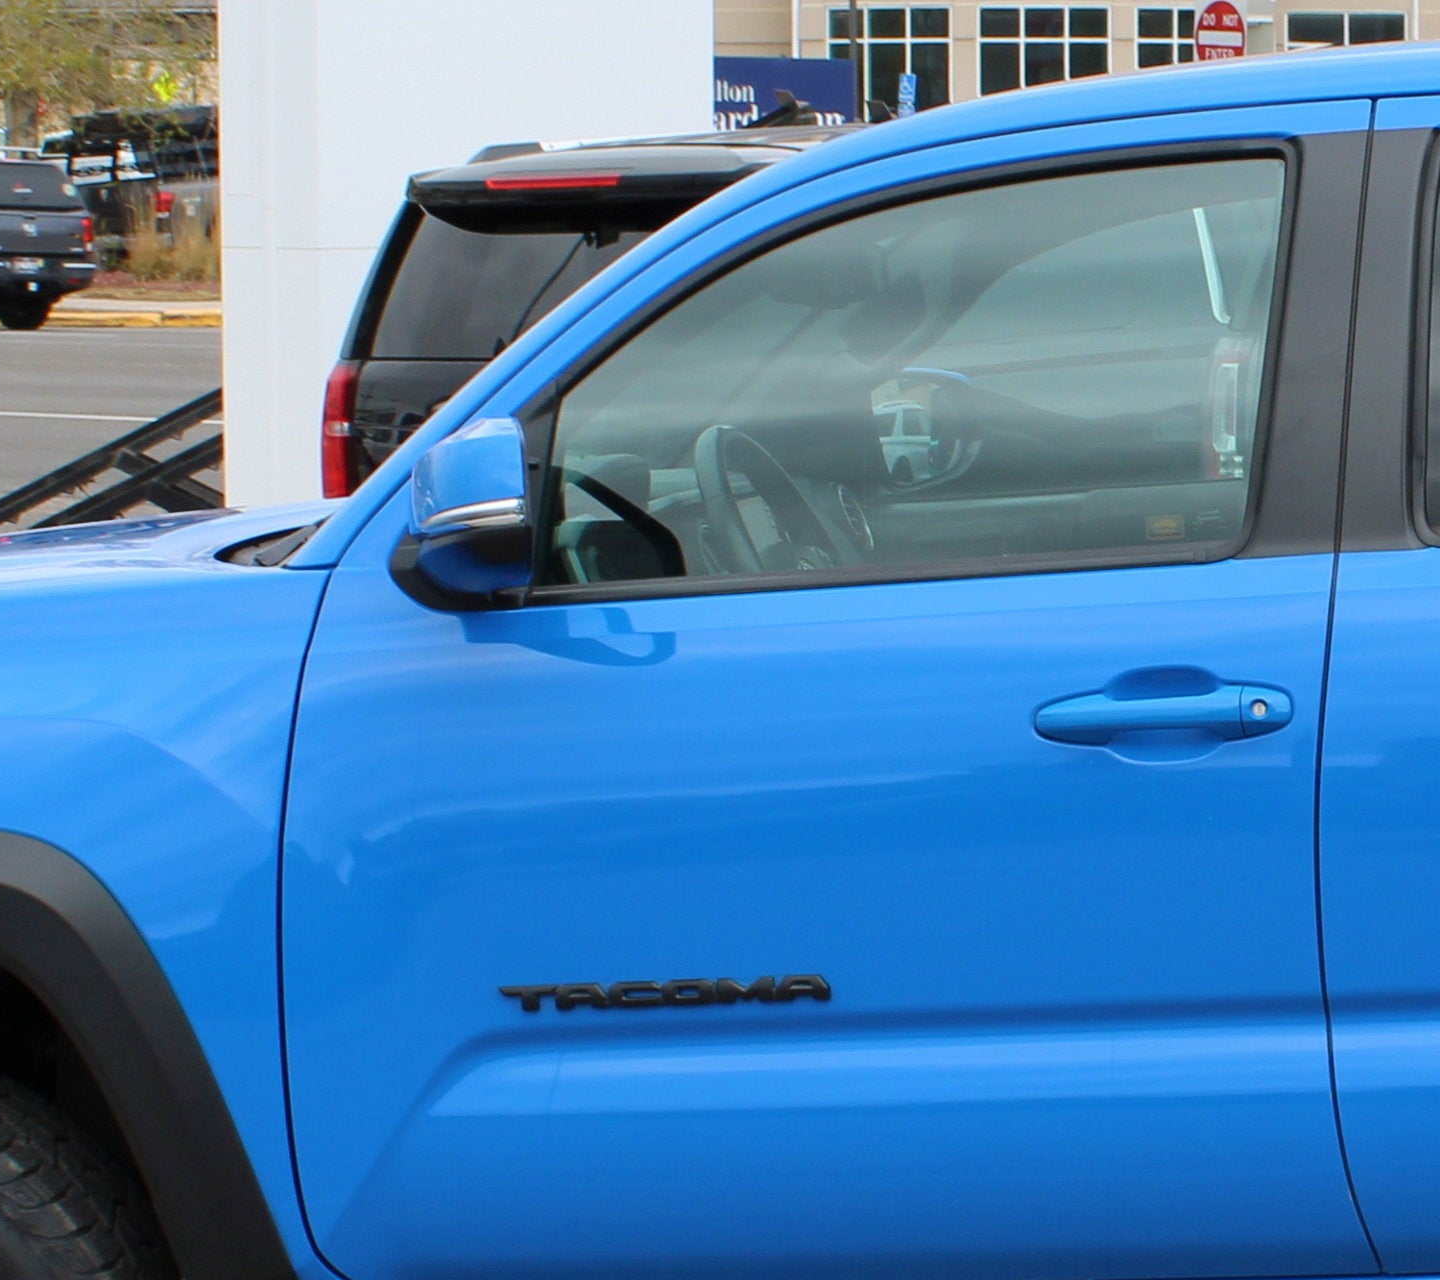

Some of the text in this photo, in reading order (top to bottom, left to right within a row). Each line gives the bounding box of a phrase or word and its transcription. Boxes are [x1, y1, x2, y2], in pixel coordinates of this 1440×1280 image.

[1203, 13, 1239, 28] DO NOT
[498, 973, 831, 1012] TACOMA
